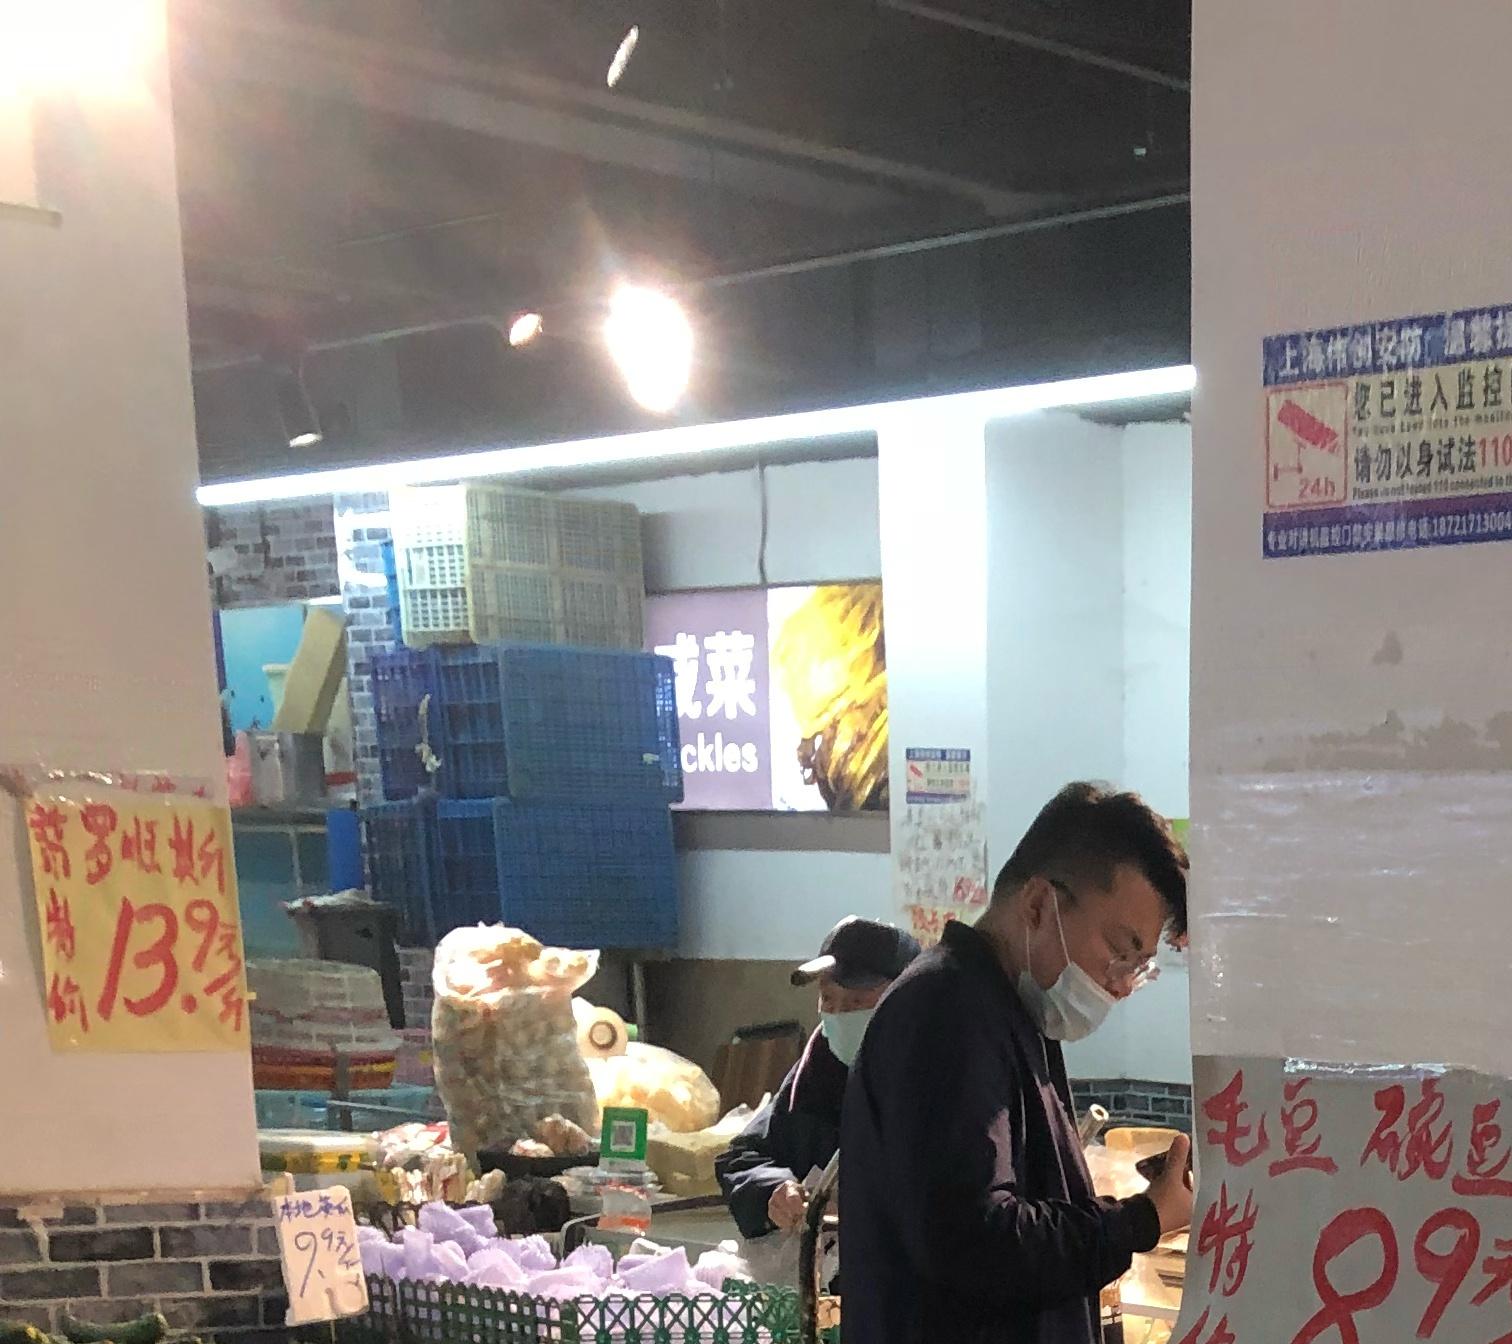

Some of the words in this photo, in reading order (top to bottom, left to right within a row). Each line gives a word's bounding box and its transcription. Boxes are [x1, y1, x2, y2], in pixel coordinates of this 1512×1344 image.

[1299, 476, 1335, 498] 24h
[681, 732, 758, 772] ckles
[1202, 1069, 1339, 1178] 毛豆
